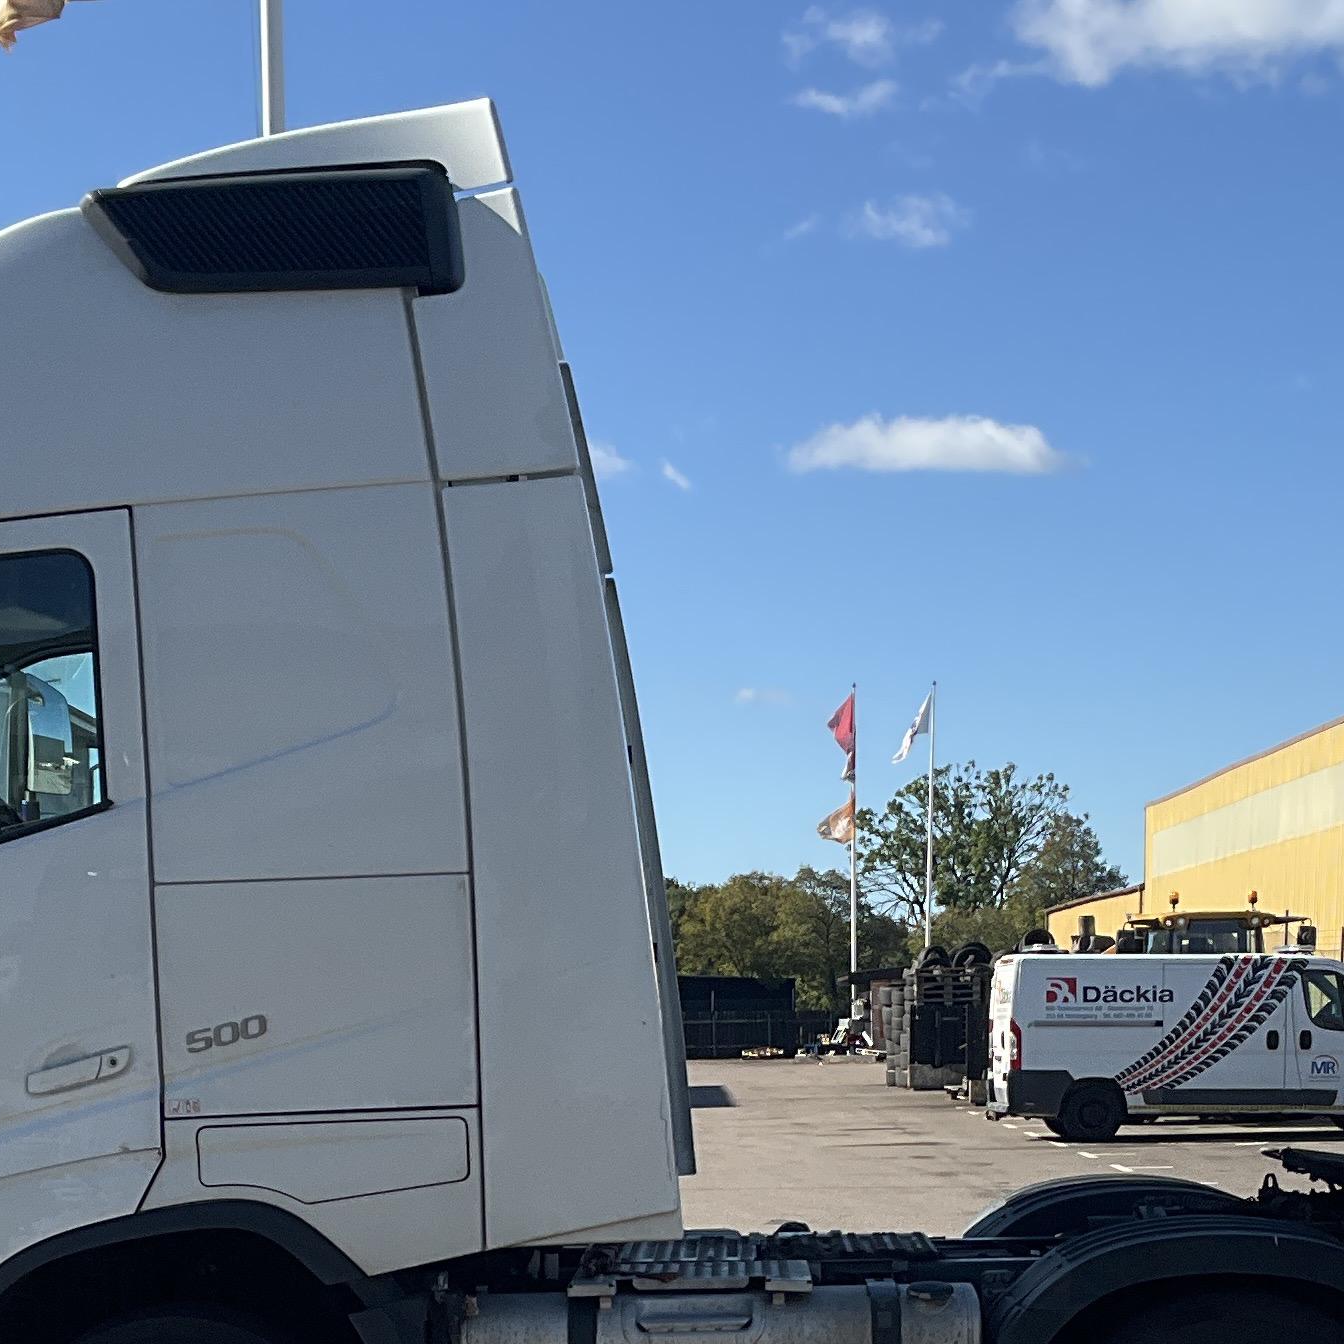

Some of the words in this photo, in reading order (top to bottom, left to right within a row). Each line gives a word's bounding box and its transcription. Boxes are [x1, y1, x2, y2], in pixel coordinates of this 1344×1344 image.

[1083, 985, 1174, 1003] Däckia
[186, 1014, 267, 1053] 500
[1311, 1061, 1336, 1075] MR
